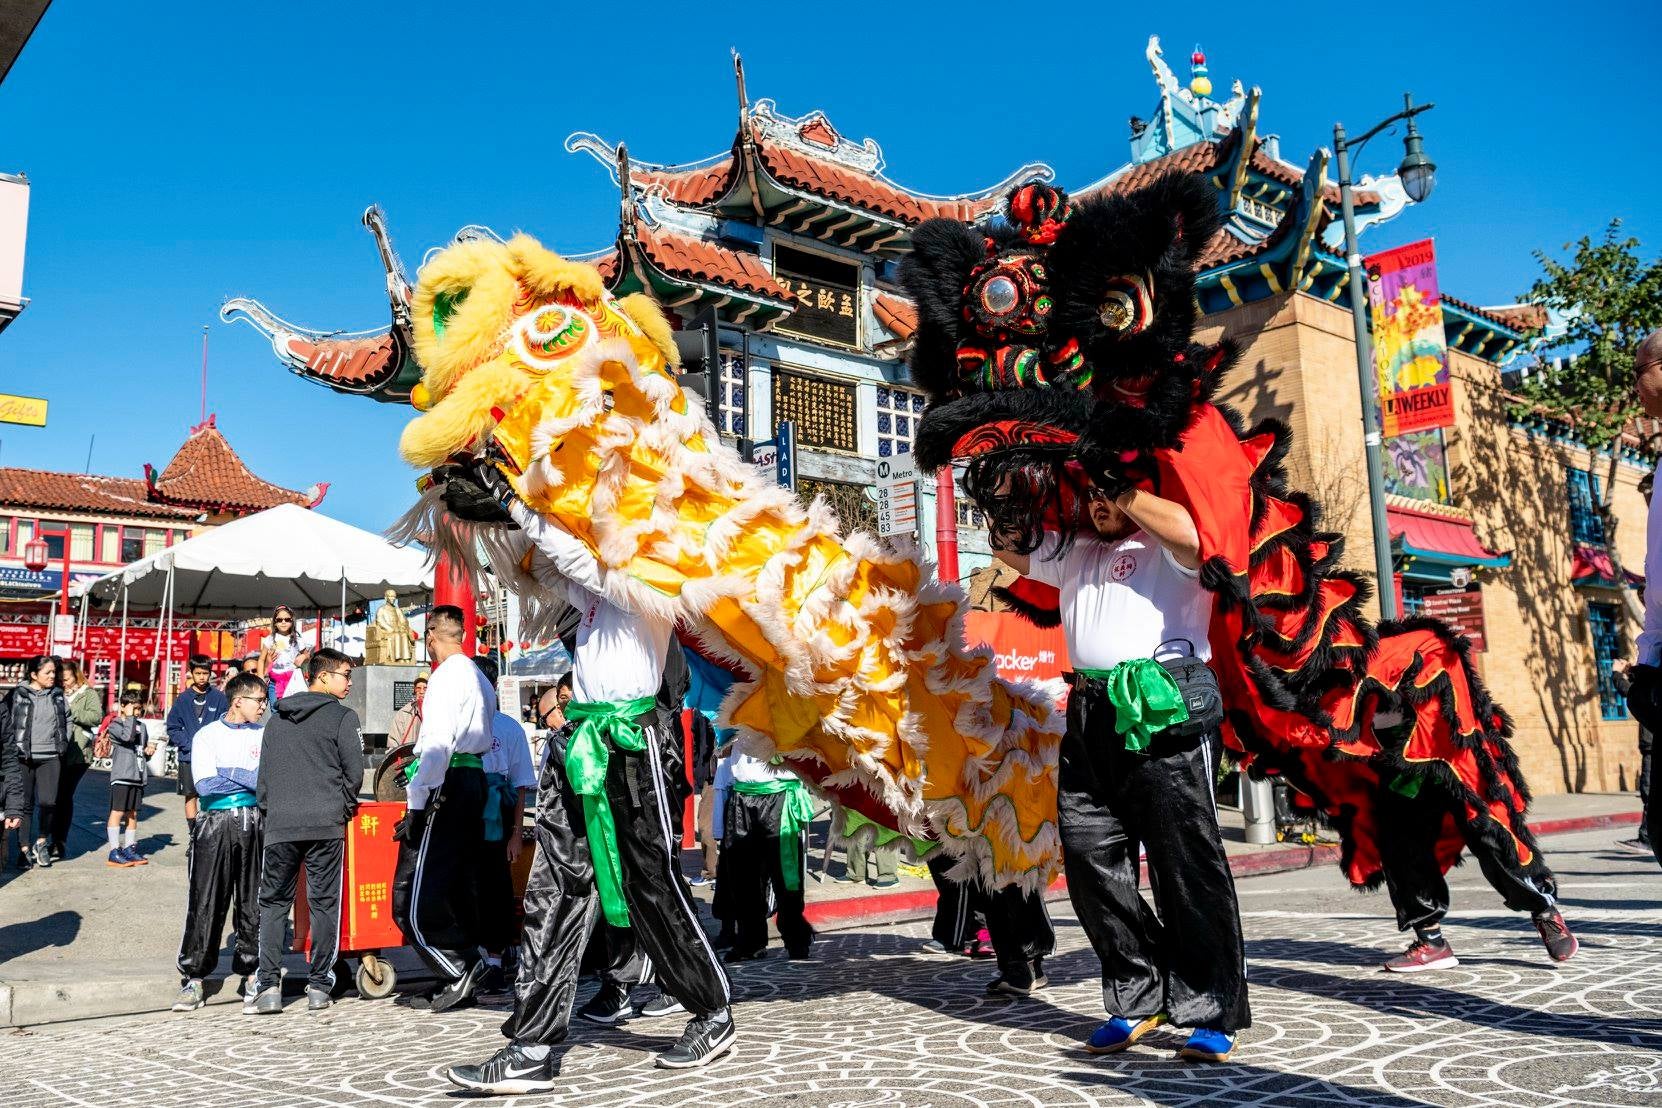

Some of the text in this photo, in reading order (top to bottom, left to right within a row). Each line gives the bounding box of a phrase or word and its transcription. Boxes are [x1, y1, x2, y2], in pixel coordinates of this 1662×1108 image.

[1401, 387, 1449, 413] WEEKLY
[892, 470, 913, 480] Metro
[878, 488, 889, 499] 28
[879, 500, 889, 510] 28
[880, 511, 891, 522] 45
[880, 522, 891, 533] 83
[991, 647, 1039, 671] acker
